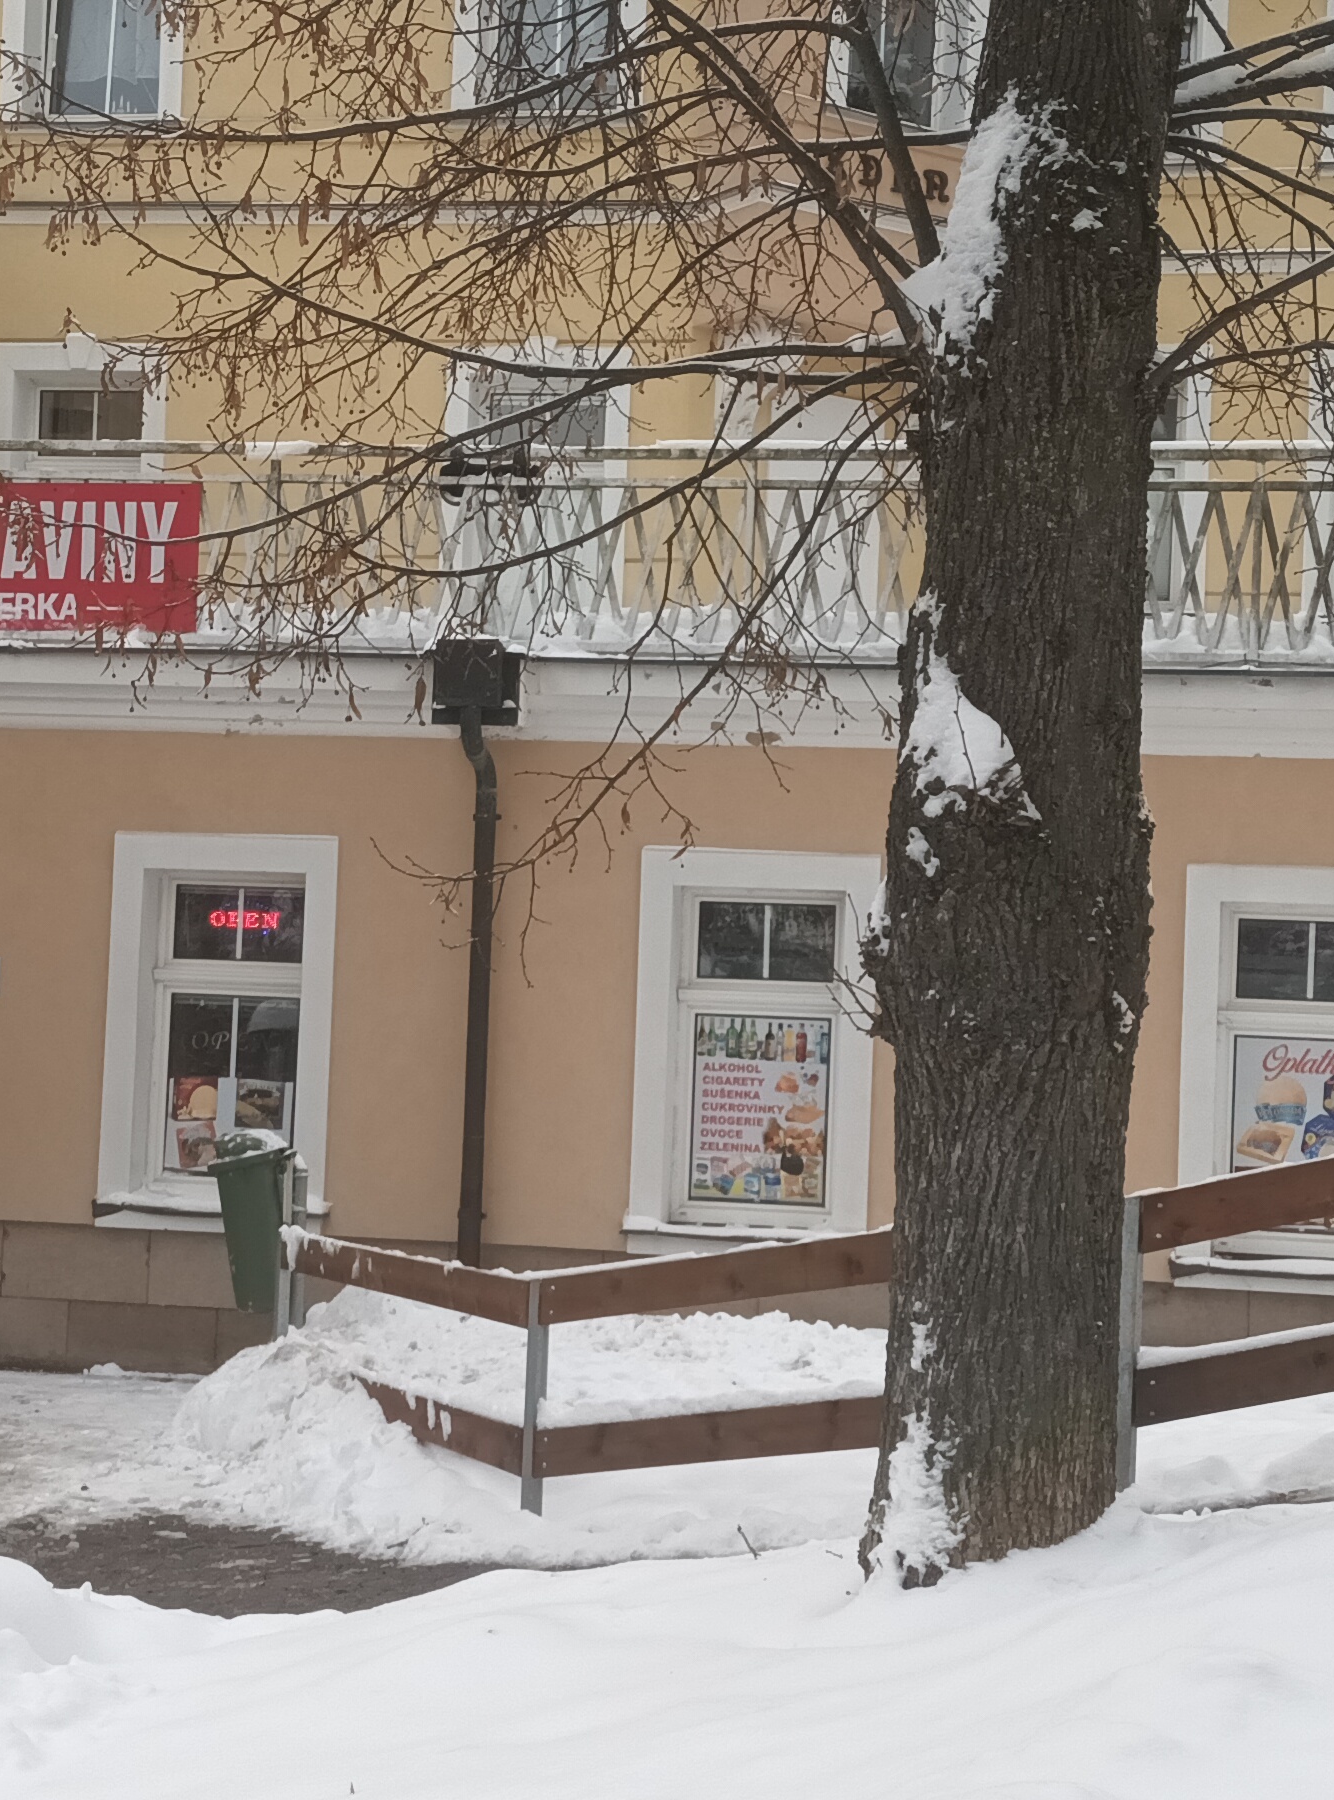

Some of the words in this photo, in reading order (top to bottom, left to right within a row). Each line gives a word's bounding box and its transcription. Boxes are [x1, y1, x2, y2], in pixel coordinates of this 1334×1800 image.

[210, 909, 282, 929] OPEN
[702, 1062, 763, 1074] ALKOHOL
[702, 1075, 765, 1087] CIGARETY
[702, 1088, 761, 1100] SUŠENKA
[701, 1102, 785, 1115] CUKROVINKY
[701, 1115, 764, 1127] DROGERIE
[700, 1128, 743, 1140] OVOCE
[700, 1141, 762, 1153] ZELENINA
